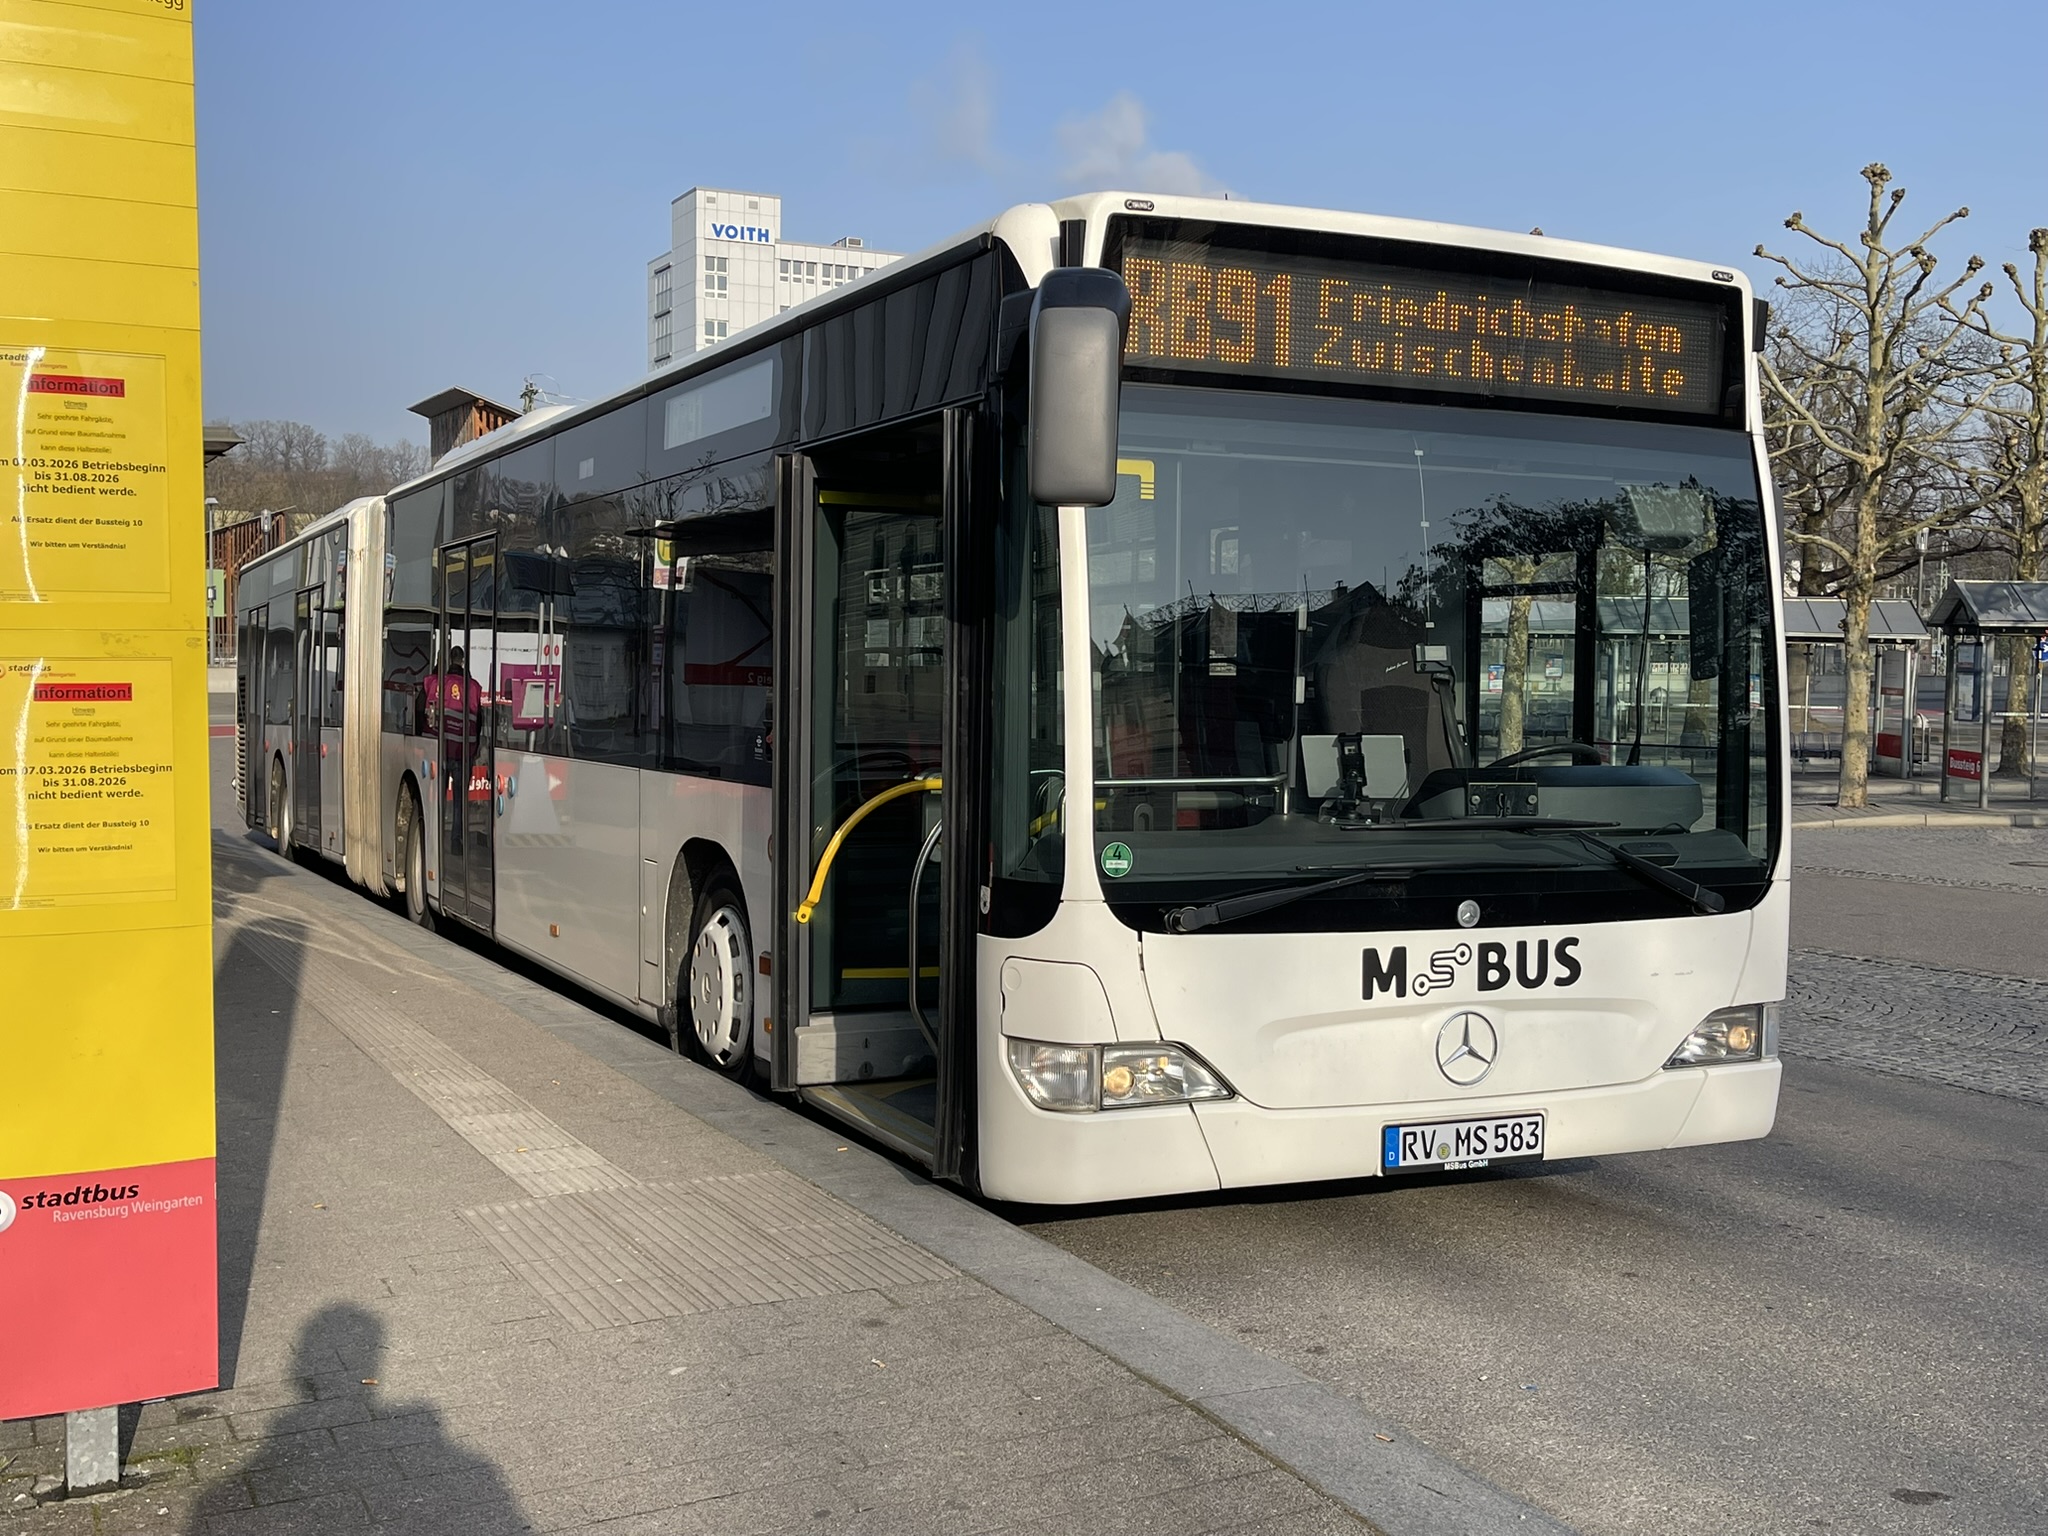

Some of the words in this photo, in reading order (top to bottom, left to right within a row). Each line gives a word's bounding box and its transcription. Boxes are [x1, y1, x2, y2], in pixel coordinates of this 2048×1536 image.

[712, 223, 770, 242] VOITH
[1124, 257, 1291, 367] RB91
[30, 378, 124, 394] nformation!
[37, 428, 58, 436] Grund
[82, 460, 166, 474] Betriebsbeginn
[34, 471, 51, 480] bis
[54, 472, 120, 483] 31.08.2026
[52, 484, 96, 494] bedient
[99, 487, 137, 496] werde.
[27, 516, 53, 524] Ersatz
[95, 518, 130, 527] Bussteig
[8, 664, 52, 672] stadtus
[90, 763, 172, 774] Betriebsbeginn
[43, 778, 59, 787] bis
[62, 777, 126, 787] 31.08.2026
[28, 791, 57, 800] nicht
[60, 790, 103, 799] bedient
[106, 789, 144, 798] werde.
[34, 822, 61, 830] Ersatz
[87, 821, 100, 829] der
[102, 820, 137, 829] Bussteig
[52, 845, 74, 853] bitten
[89, 844, 133, 852] Verständnis!
[1113, 844, 1121, 860] 4
[1388, 1152, 1395, 1161] D
[1402, 1129, 1436, 1161] RV
[1444, 1161, 1467, 1170] MSBus
[1468, 1159, 1488, 1169] GmbH
[20, 1184, 140, 1210] stadtbus
[53, 1205, 129, 1223] Ravensburg
[132, 1196, 203, 1214] Weingarten
